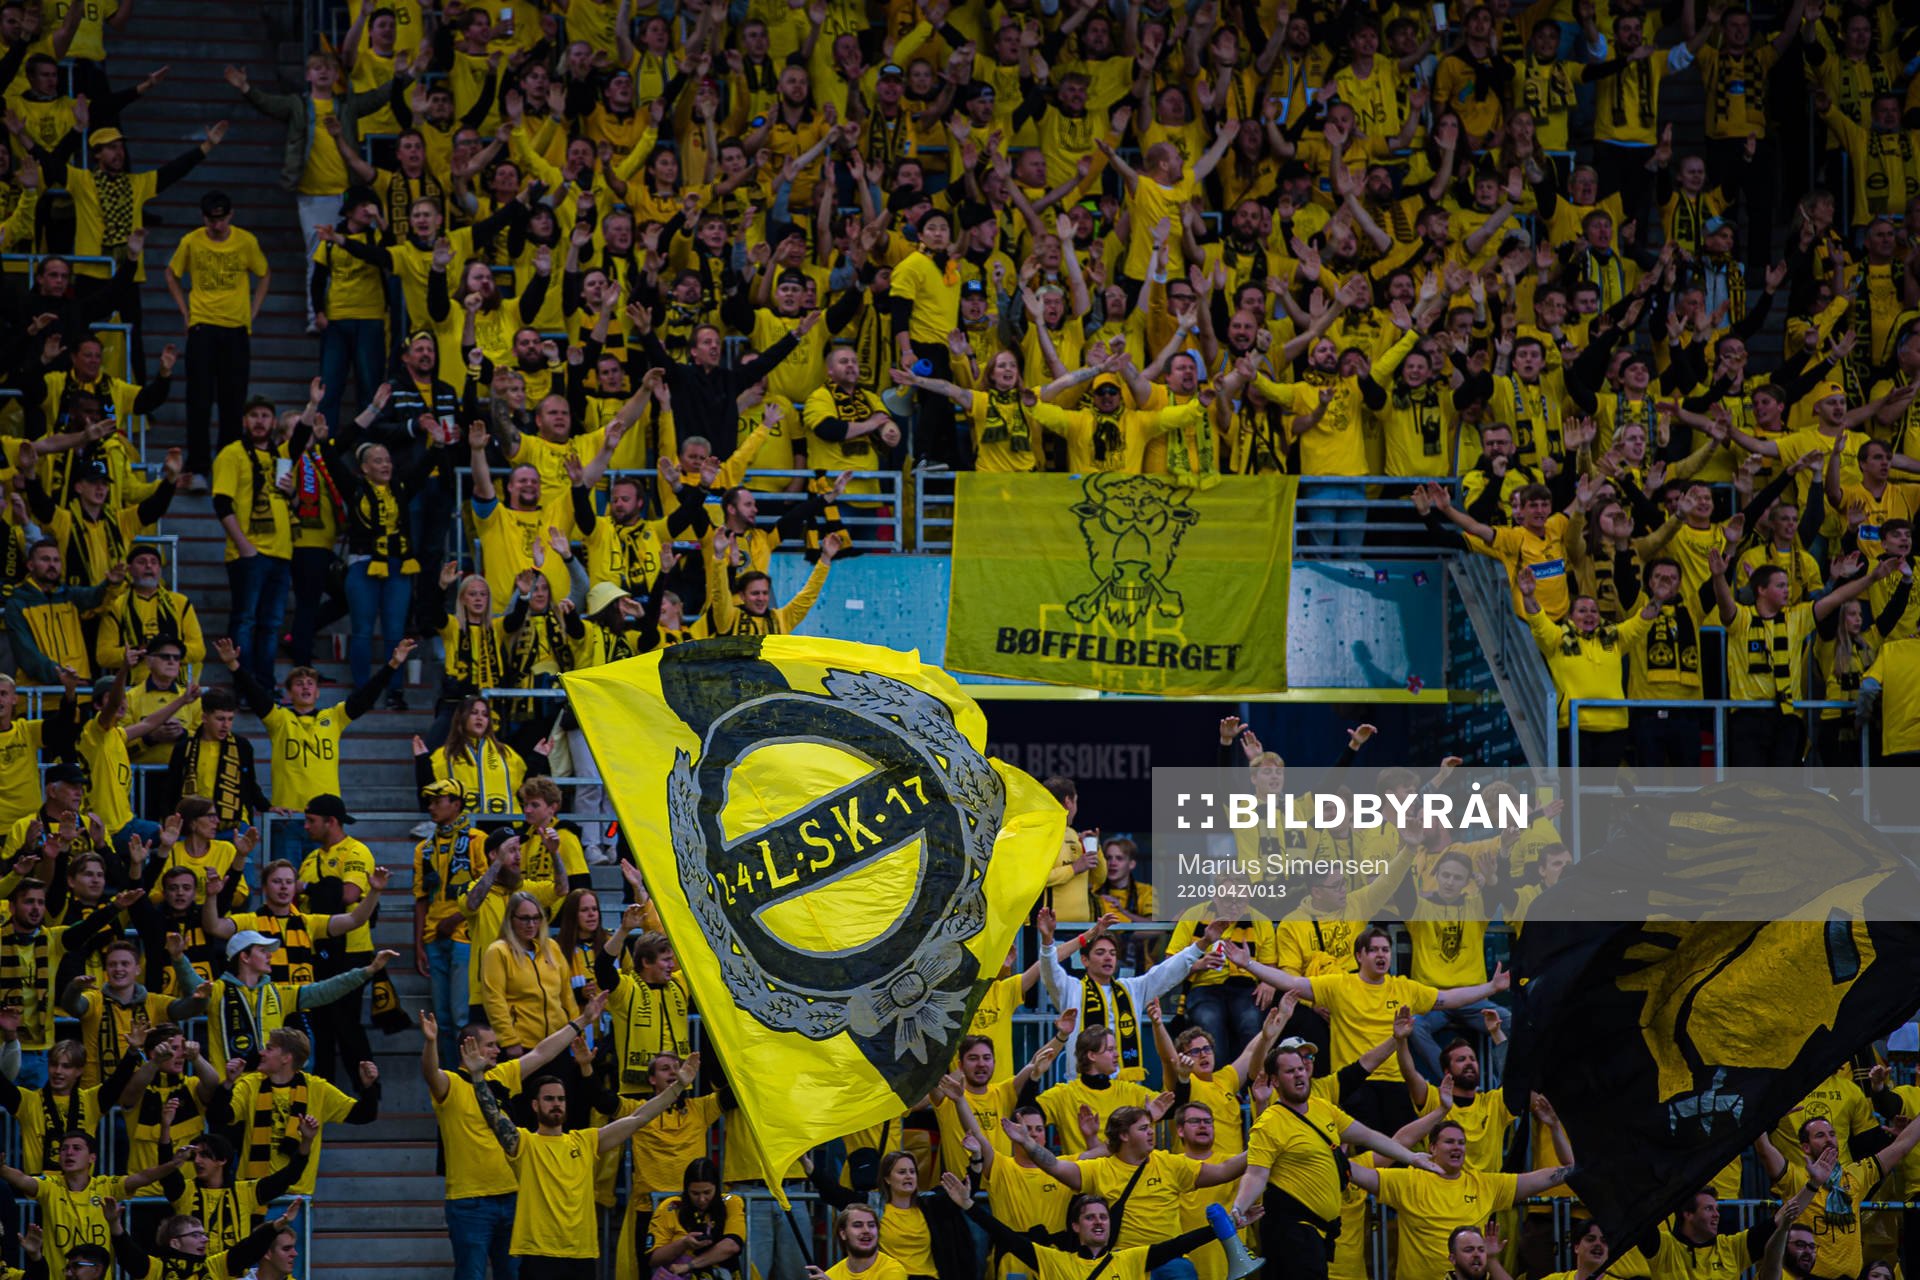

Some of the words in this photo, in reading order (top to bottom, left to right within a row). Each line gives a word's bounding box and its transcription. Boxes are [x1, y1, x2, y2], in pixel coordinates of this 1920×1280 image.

[56, 2, 99, 22] DB
[610, 551, 656, 572] DB
[996, 626, 1242, 671] BØFFELBERGET
[285, 734, 334, 768] DNB
[1026, 743, 1151, 780] BESØKET!
[55, 1216, 105, 1248] DNB
